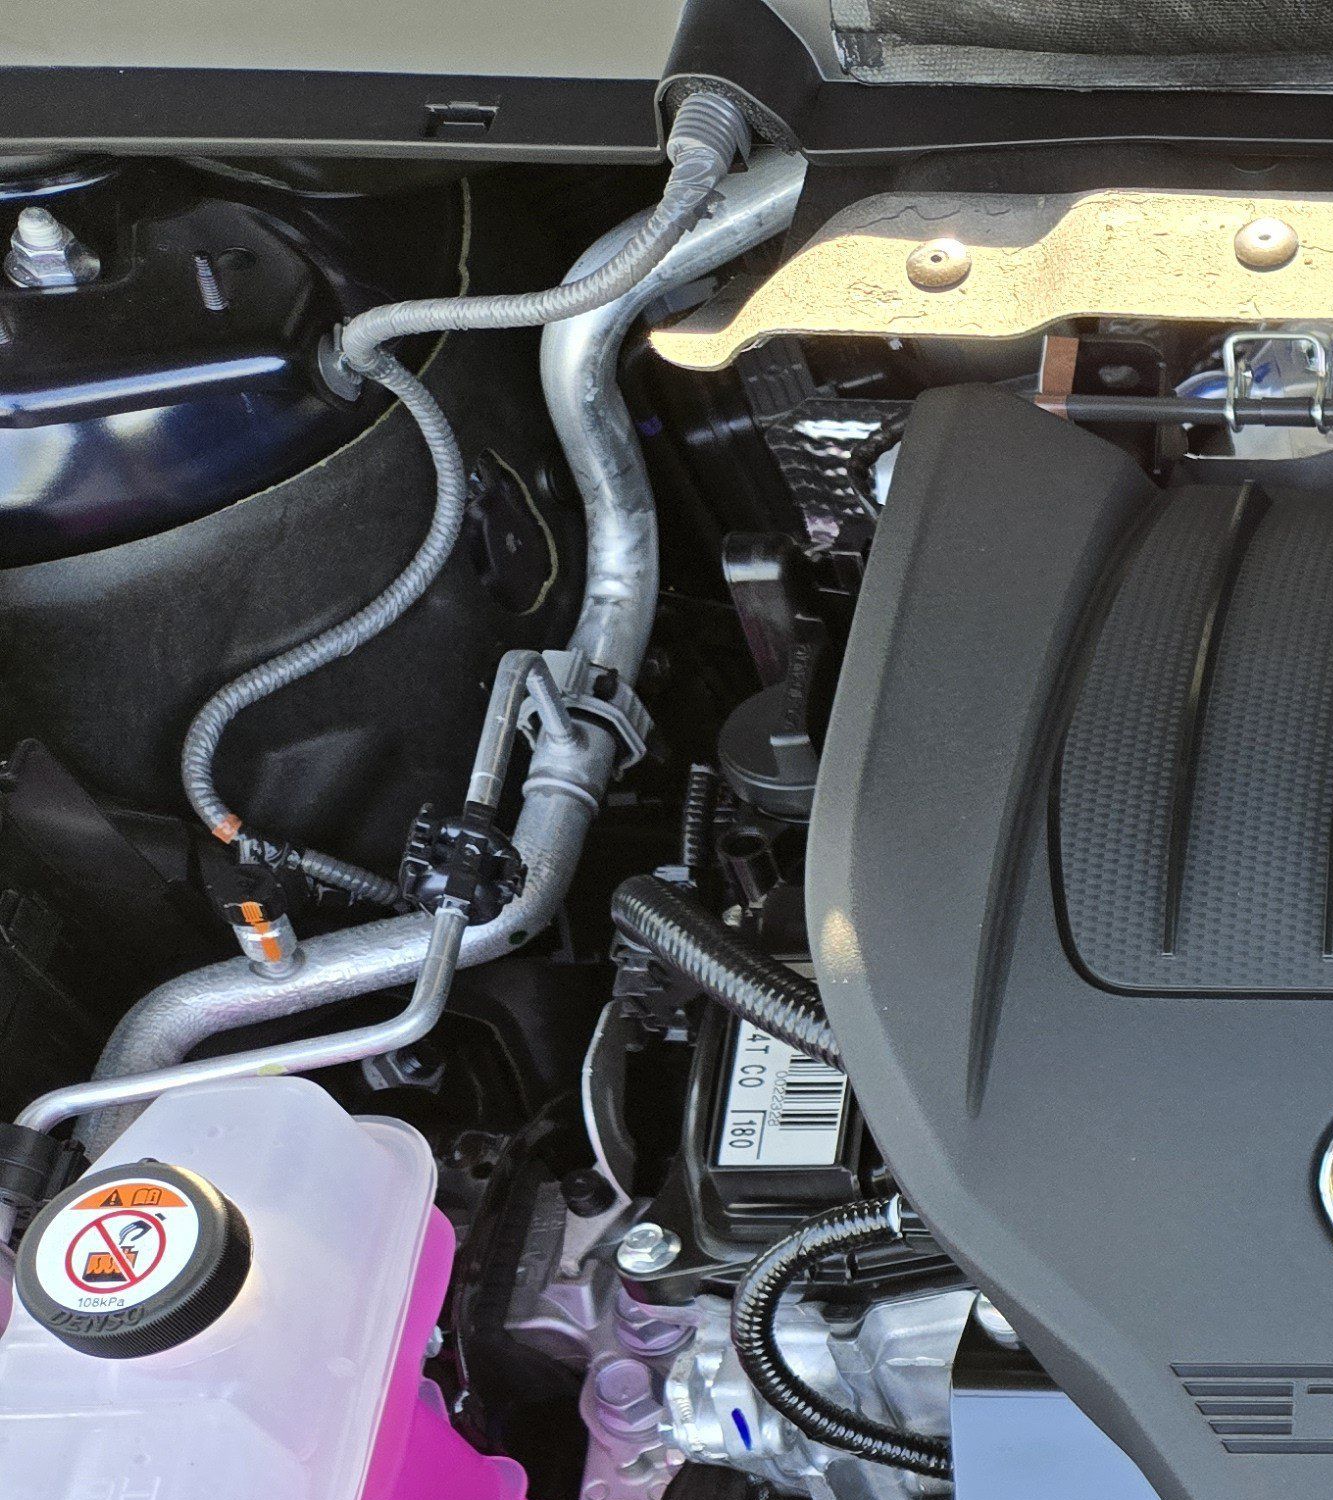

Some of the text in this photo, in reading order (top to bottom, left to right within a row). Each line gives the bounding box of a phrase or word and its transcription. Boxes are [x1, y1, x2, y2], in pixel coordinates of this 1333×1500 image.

[768, 1070, 788, 1127] 0022328
[729, 1121, 756, 1148] 180
[78, 1297, 125, 1307] 108kPa
[49, 1305, 144, 1332] DENSO
